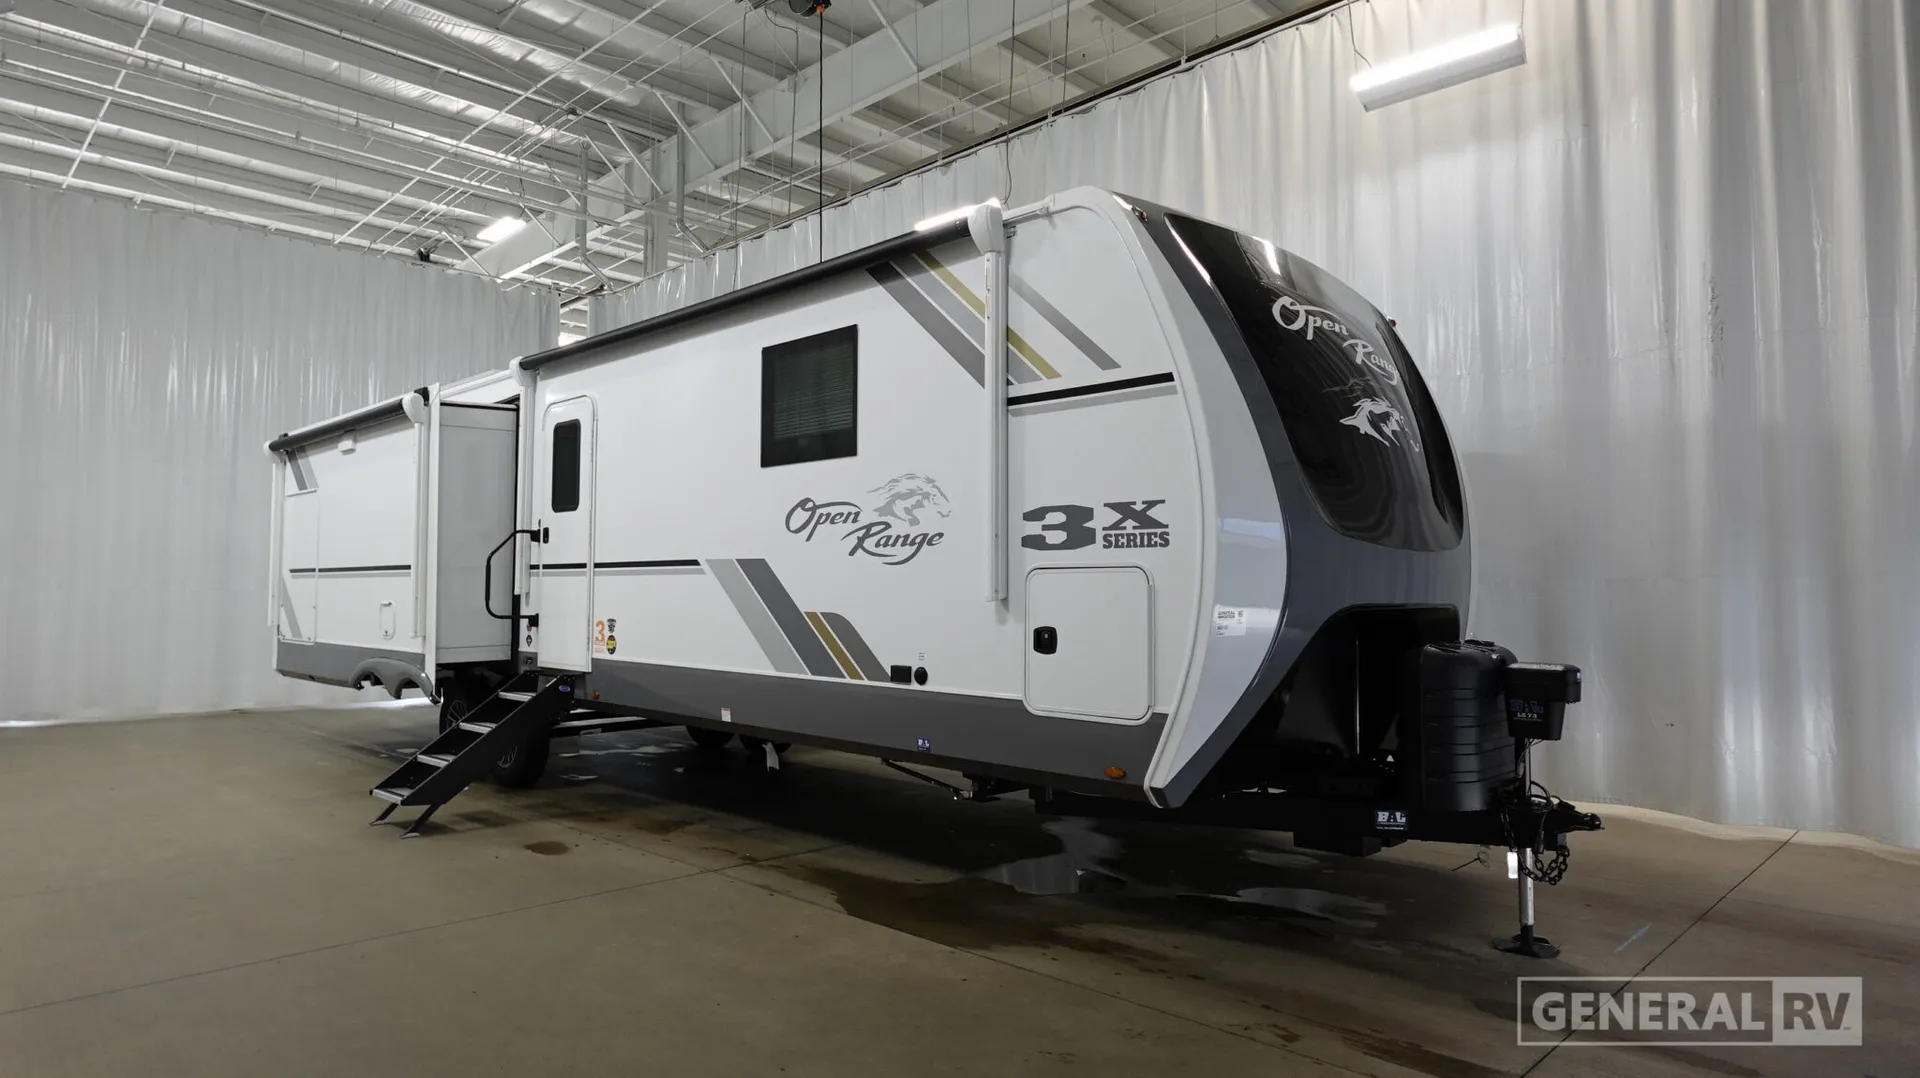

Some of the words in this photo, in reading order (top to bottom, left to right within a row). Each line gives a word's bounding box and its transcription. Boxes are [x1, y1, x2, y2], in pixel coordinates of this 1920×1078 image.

[1272, 295, 1351, 341] Open
[1342, 338, 1398, 386] Rang
[785, 497, 863, 542] Open
[1102, 531, 1171, 550] SERIES
[841, 520, 945, 566] Range
